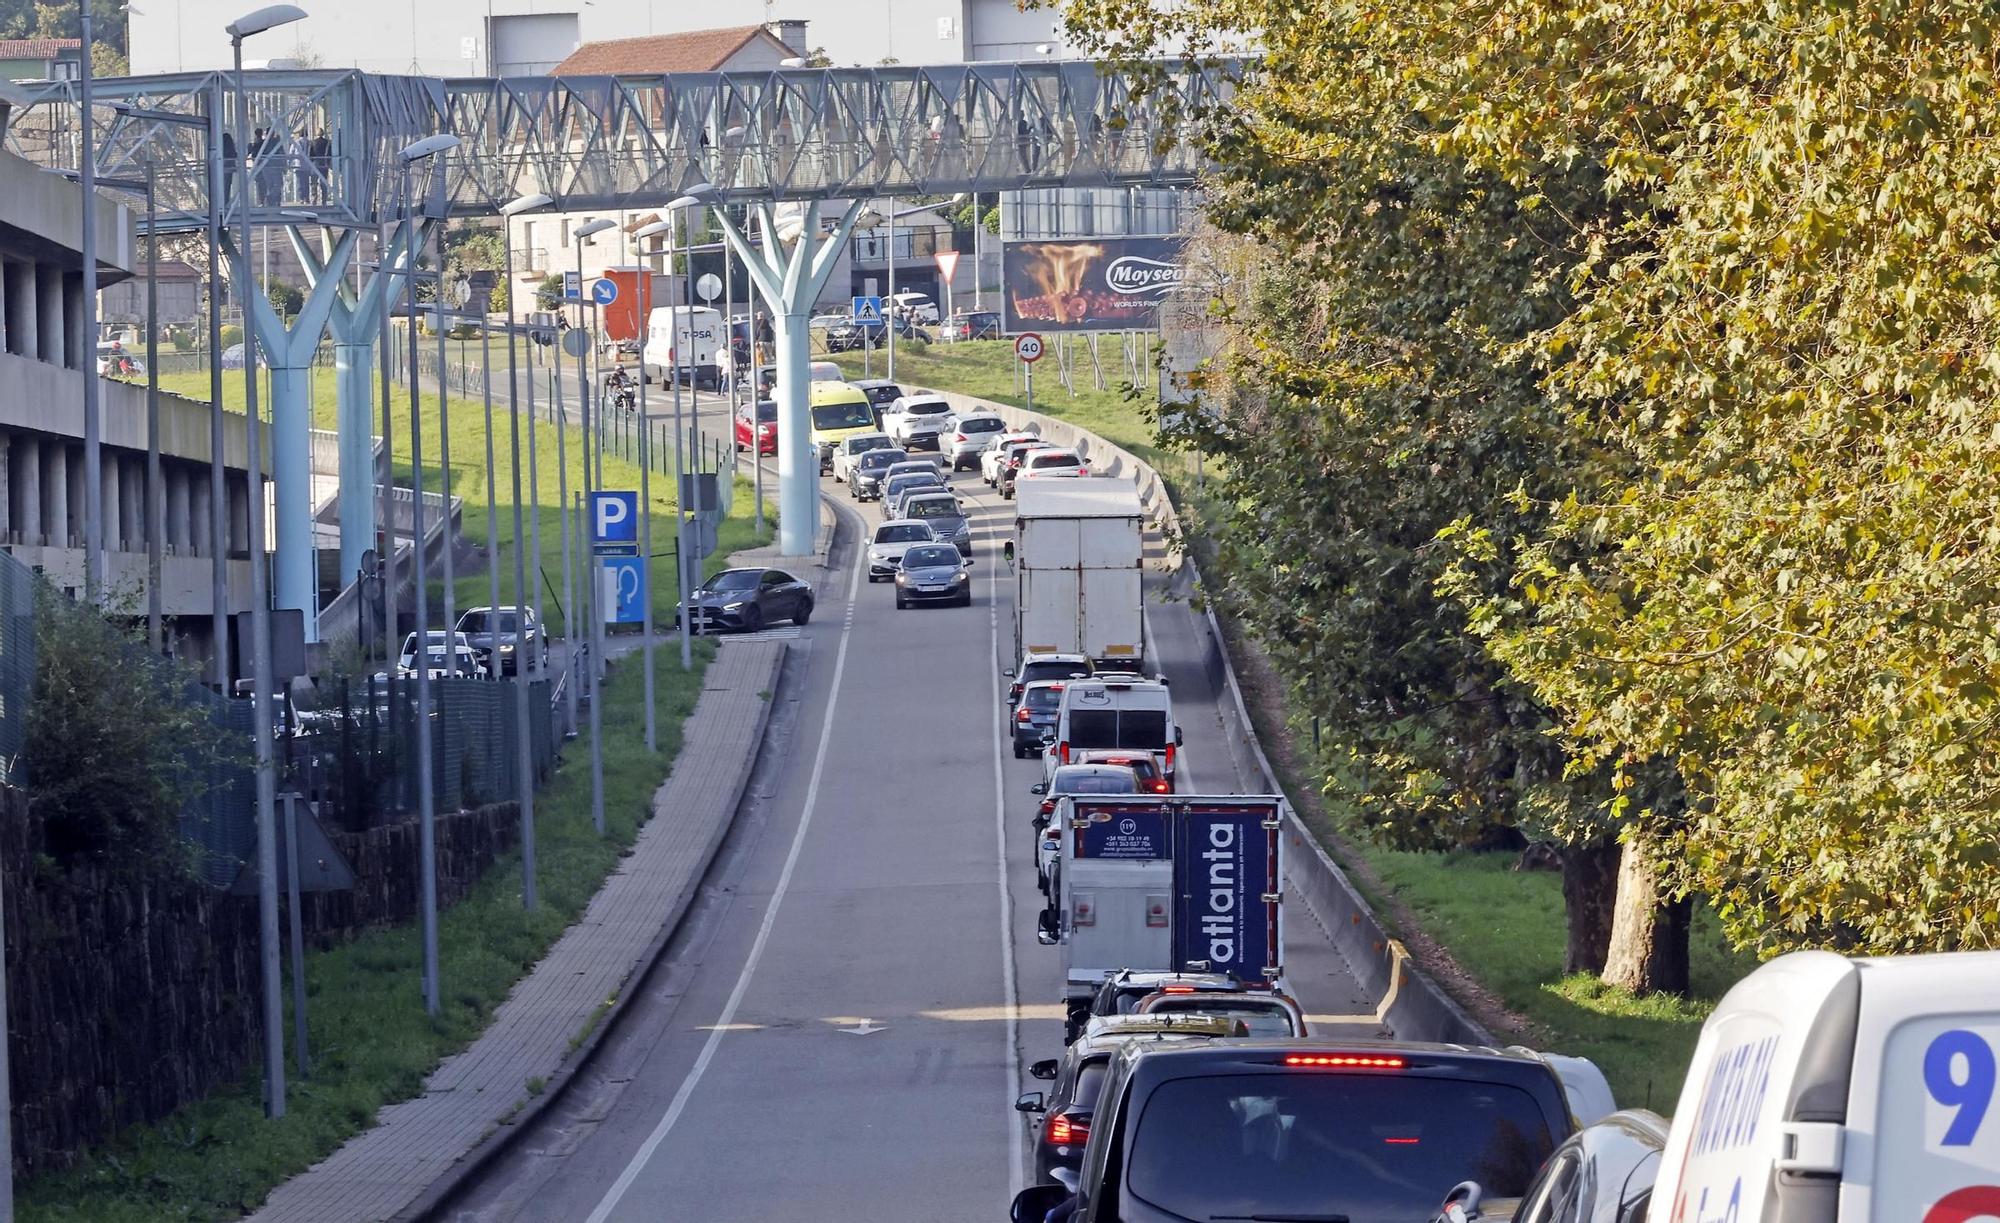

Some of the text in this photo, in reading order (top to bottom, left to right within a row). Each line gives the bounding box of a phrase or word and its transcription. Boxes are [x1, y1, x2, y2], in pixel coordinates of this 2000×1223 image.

[1113, 266, 1186, 285] Moysea
[683, 330, 712, 339] TPSA
[1022, 343, 1038, 352] 40
[596, 497, 627, 537] P
[1202, 823, 1234, 963] atlanta
[1923, 1029, 1997, 1146] 9
